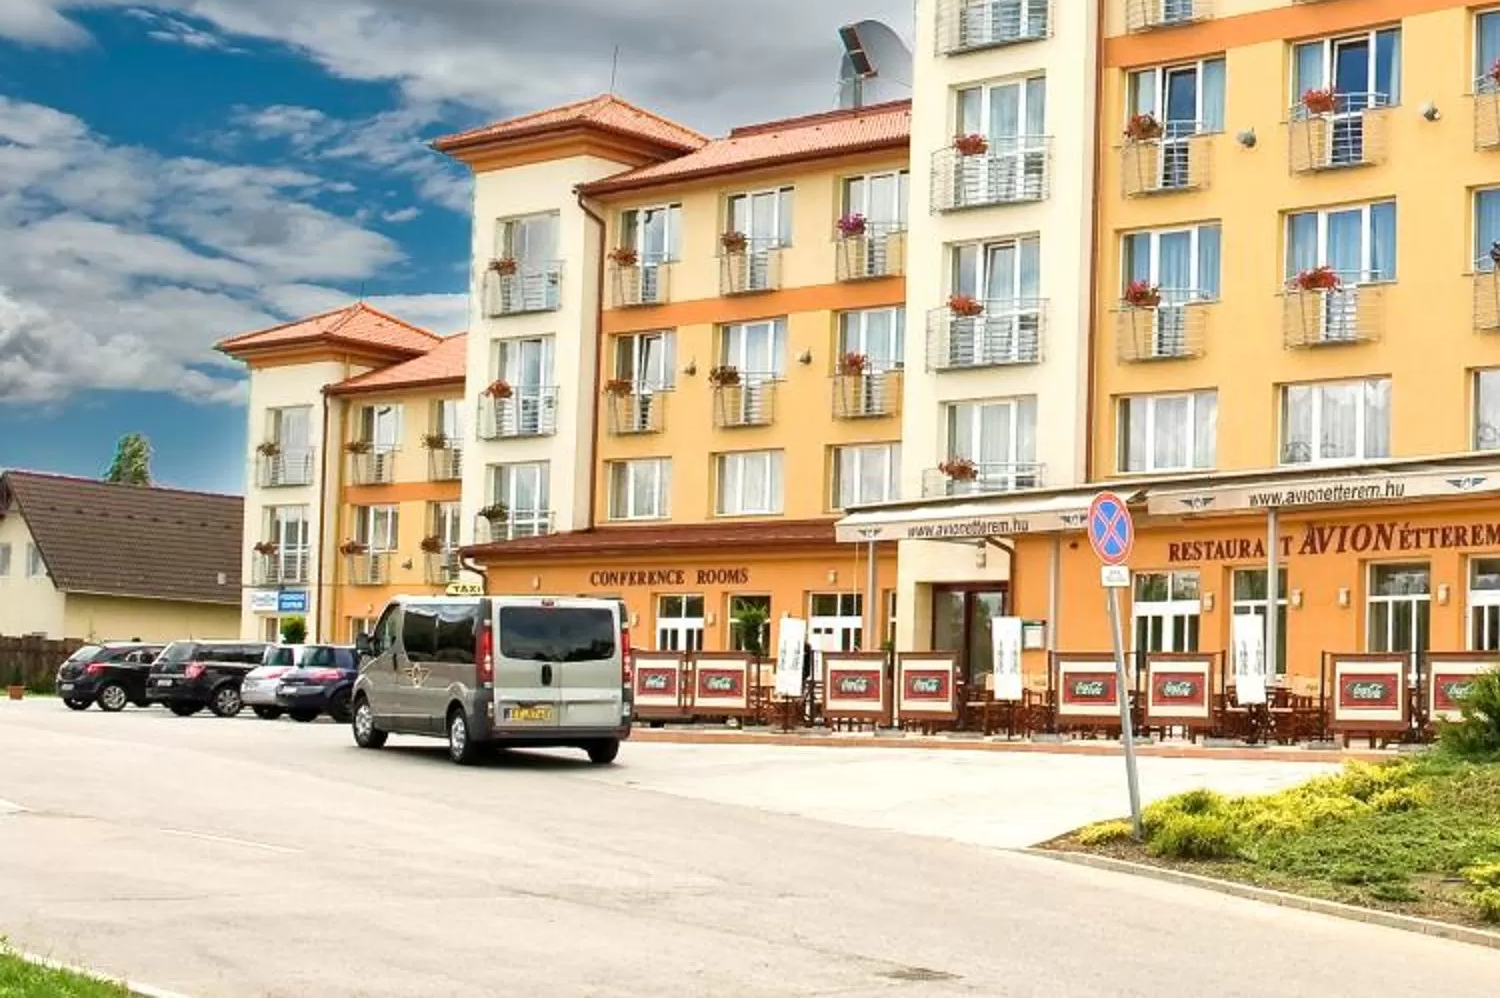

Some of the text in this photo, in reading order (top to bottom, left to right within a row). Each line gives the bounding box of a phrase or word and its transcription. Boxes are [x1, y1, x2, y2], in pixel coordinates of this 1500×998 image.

[1249, 480, 1405, 506] www.avionetterem.hu
[1168, 536, 1293, 562] RESTAURAT
[1298, 521, 1396, 554] AVION
[590, 568, 748, 586] CONFERENCE ROOMS
